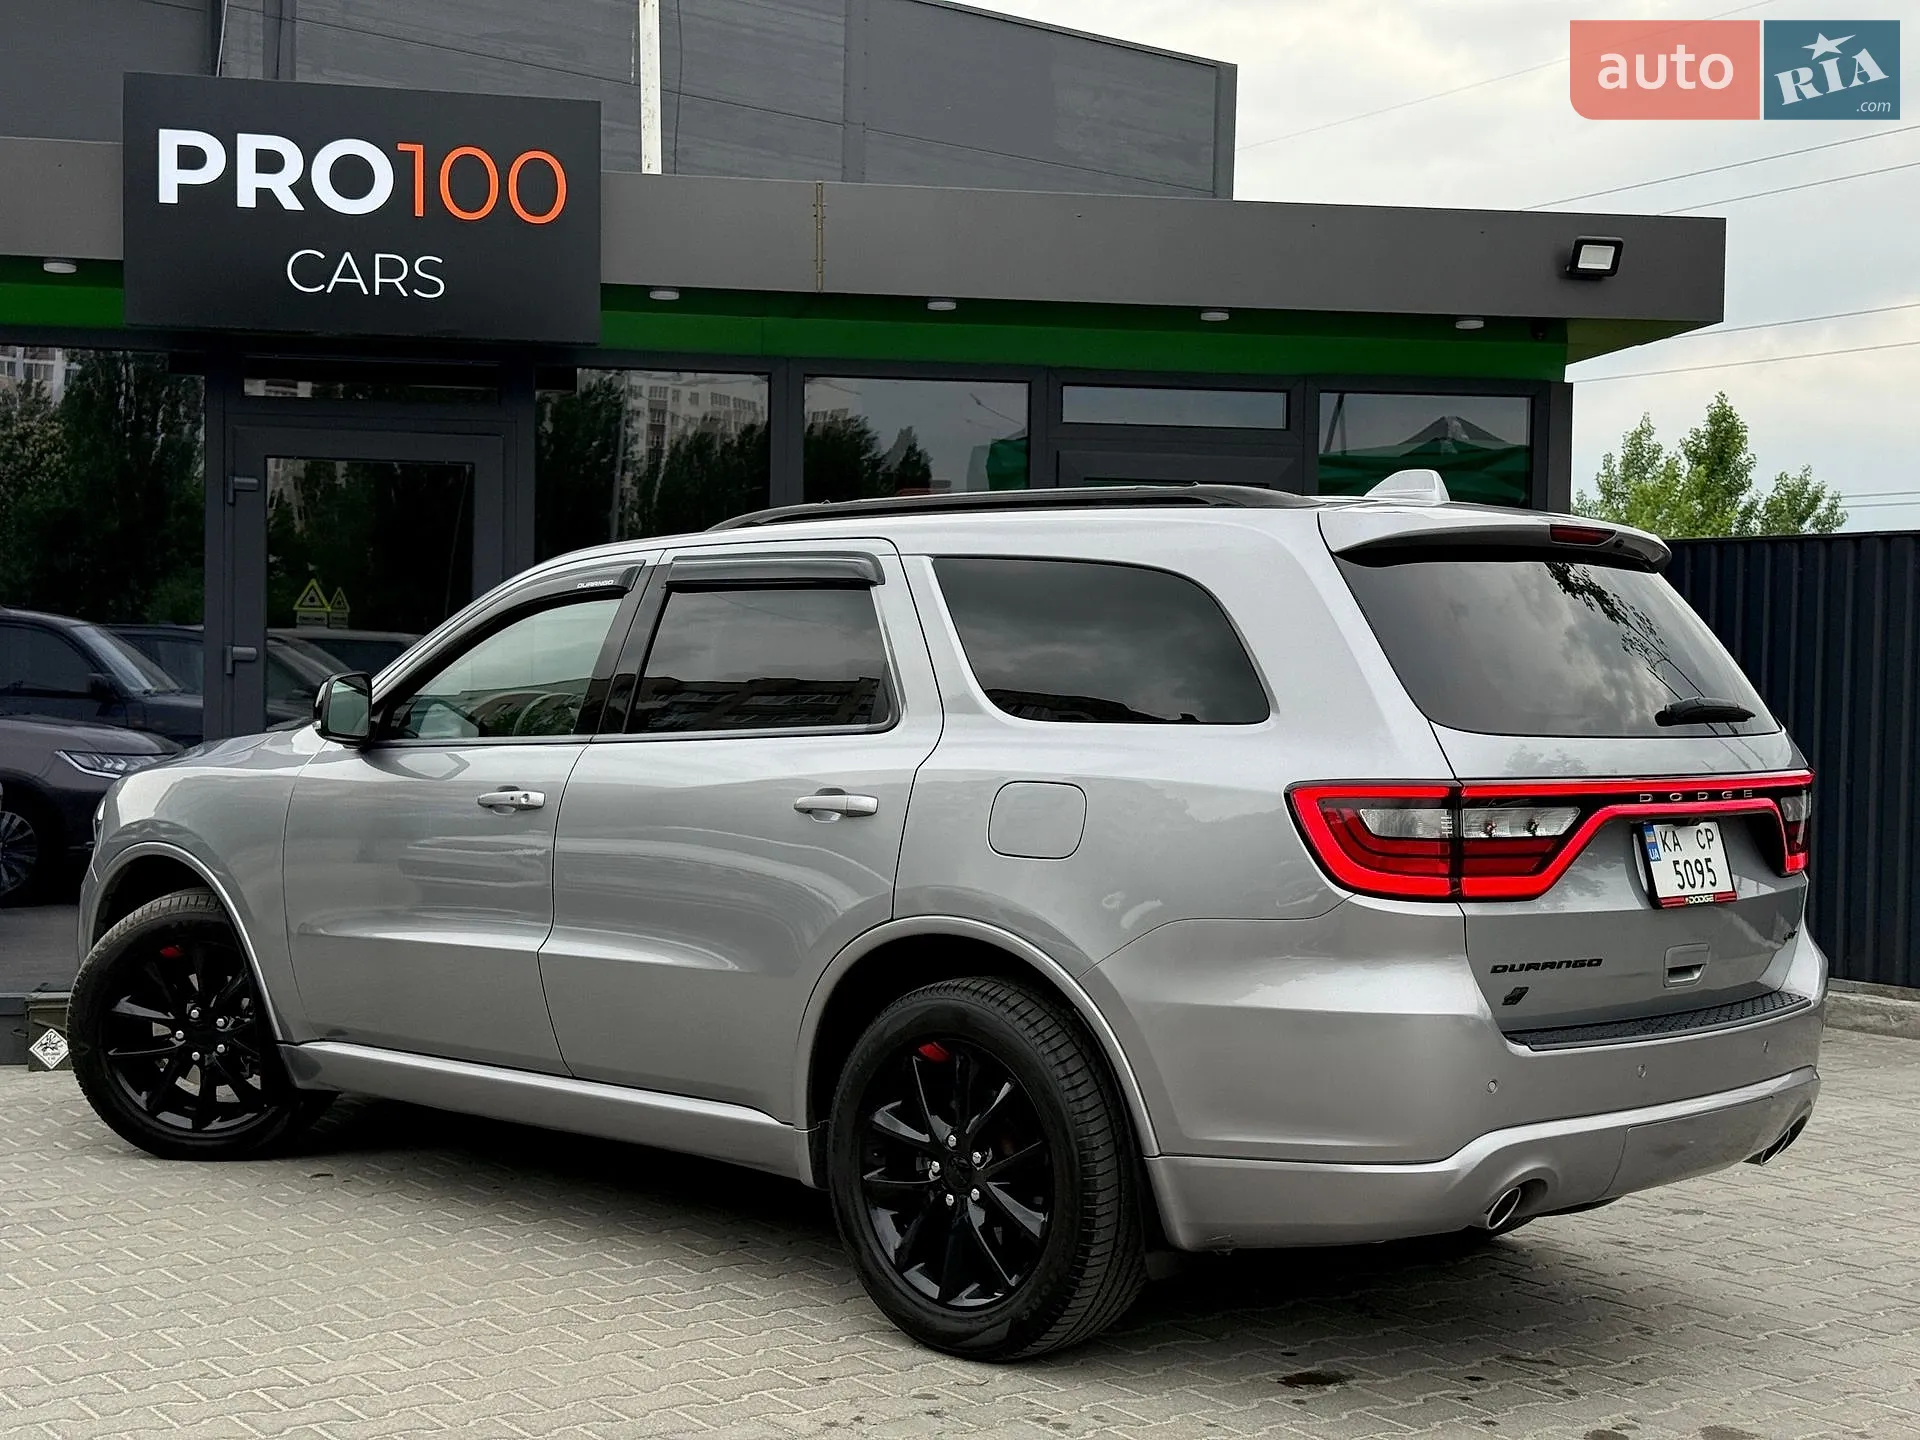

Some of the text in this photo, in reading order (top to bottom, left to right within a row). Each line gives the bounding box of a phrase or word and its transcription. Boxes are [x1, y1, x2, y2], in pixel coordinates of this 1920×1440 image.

[157, 128, 568, 225] PRO100
[286, 249, 446, 299] CARS
[577, 579, 615, 589] DURANGO
[1639, 789, 1753, 802] DODGE
[1659, 828, 1714, 852] KA CP
[1648, 848, 1661, 860] UA
[1672, 857, 1717, 889] 5095
[1688, 894, 1714, 904] DODGE
[1490, 958, 1603, 973] DURANGO
